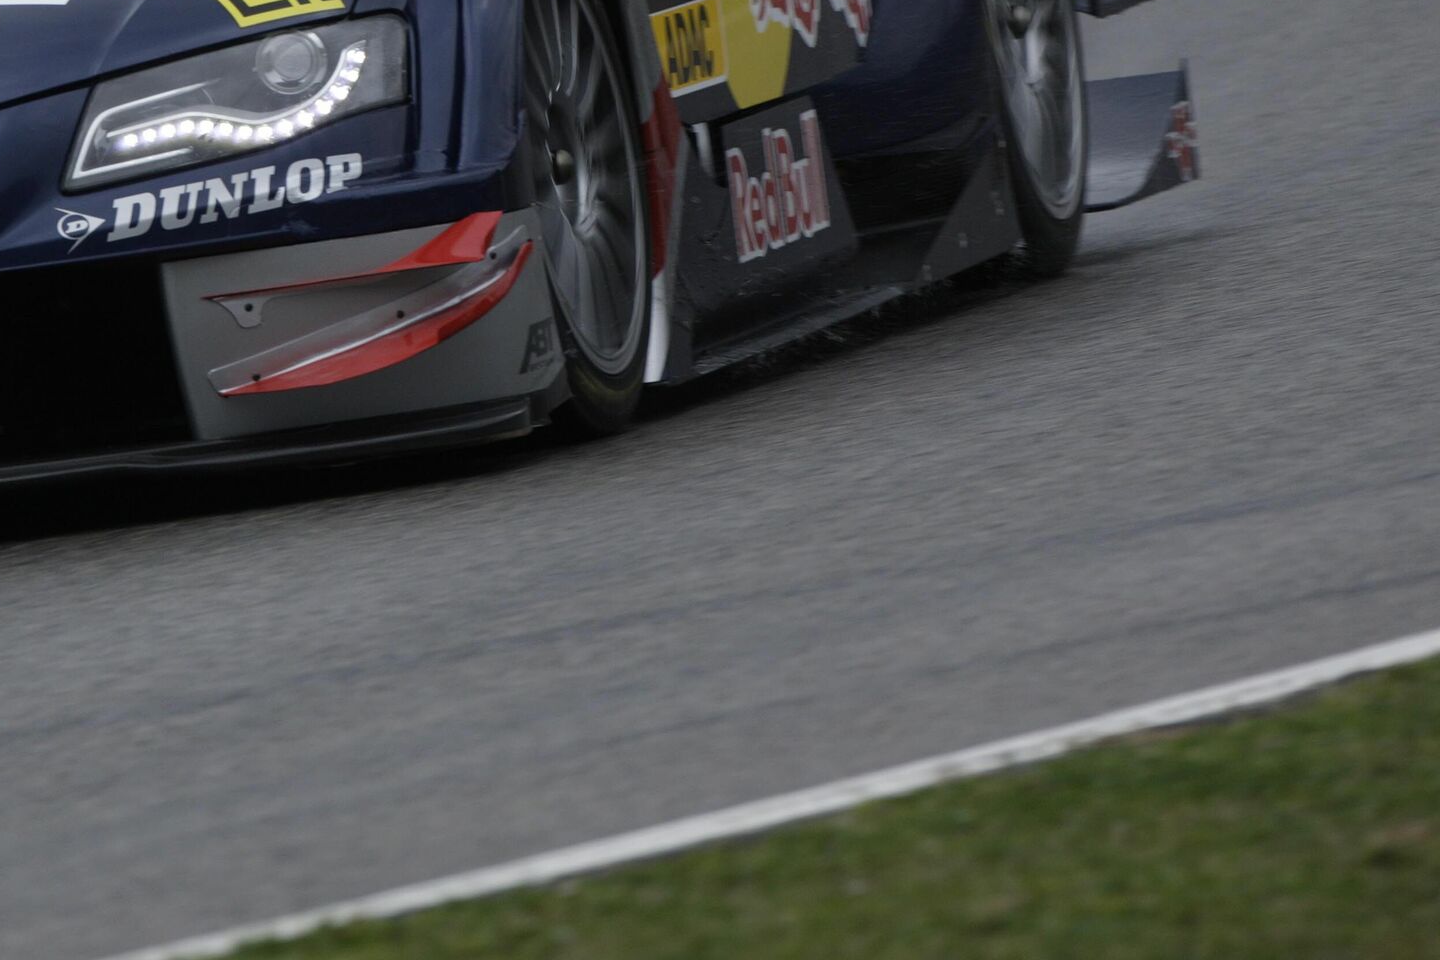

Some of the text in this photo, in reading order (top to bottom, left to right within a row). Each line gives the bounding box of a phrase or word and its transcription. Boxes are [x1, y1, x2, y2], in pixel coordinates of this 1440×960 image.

[107, 153, 362, 242] DUNLOP
[726, 109, 830, 262] Red Bull
